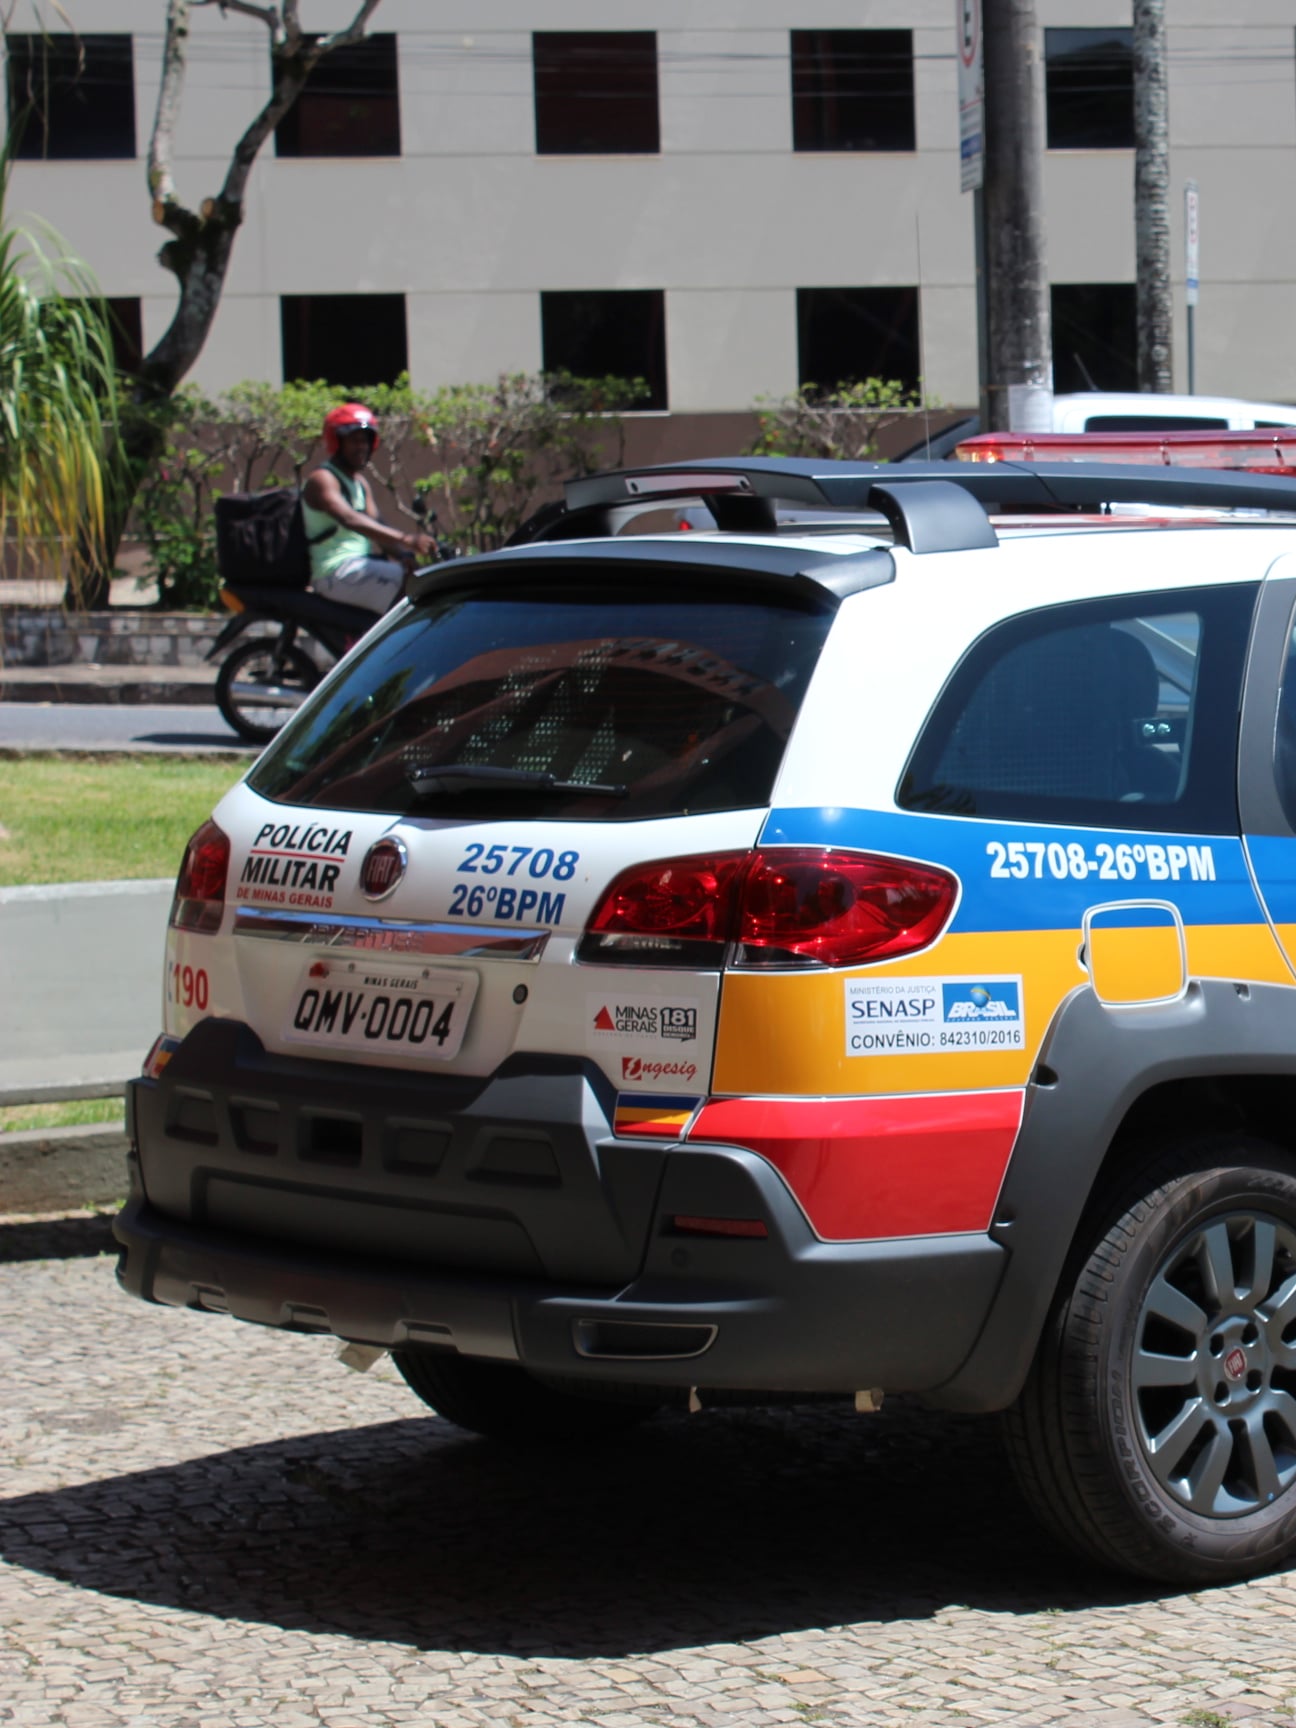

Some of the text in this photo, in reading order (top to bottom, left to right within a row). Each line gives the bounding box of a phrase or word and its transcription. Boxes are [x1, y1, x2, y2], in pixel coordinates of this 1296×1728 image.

[253, 822, 353, 856] POLÍCIA
[366, 855, 396, 883] FIAT
[456, 843, 580, 881] 25708
[240, 857, 341, 892] MILITAR
[236, 886, 333, 909] DE MINAS GERAIS
[174, 963, 208, 1011] 190
[850, 985, 936, 996] MINISTÉRIO DA JUSTIÇA
[615, 1005, 658, 1020] MINAS
[661, 1007, 697, 1026] 181
[851, 998, 936, 1019] SENASP
[947, 1001, 1017, 1019] BRASIL
[615, 1019, 658, 1033] GERAIS
[851, 1029, 1021, 1049] CONVÊNIO: 842310/2016
[1112, 1369, 1177, 1534] SCORPION
